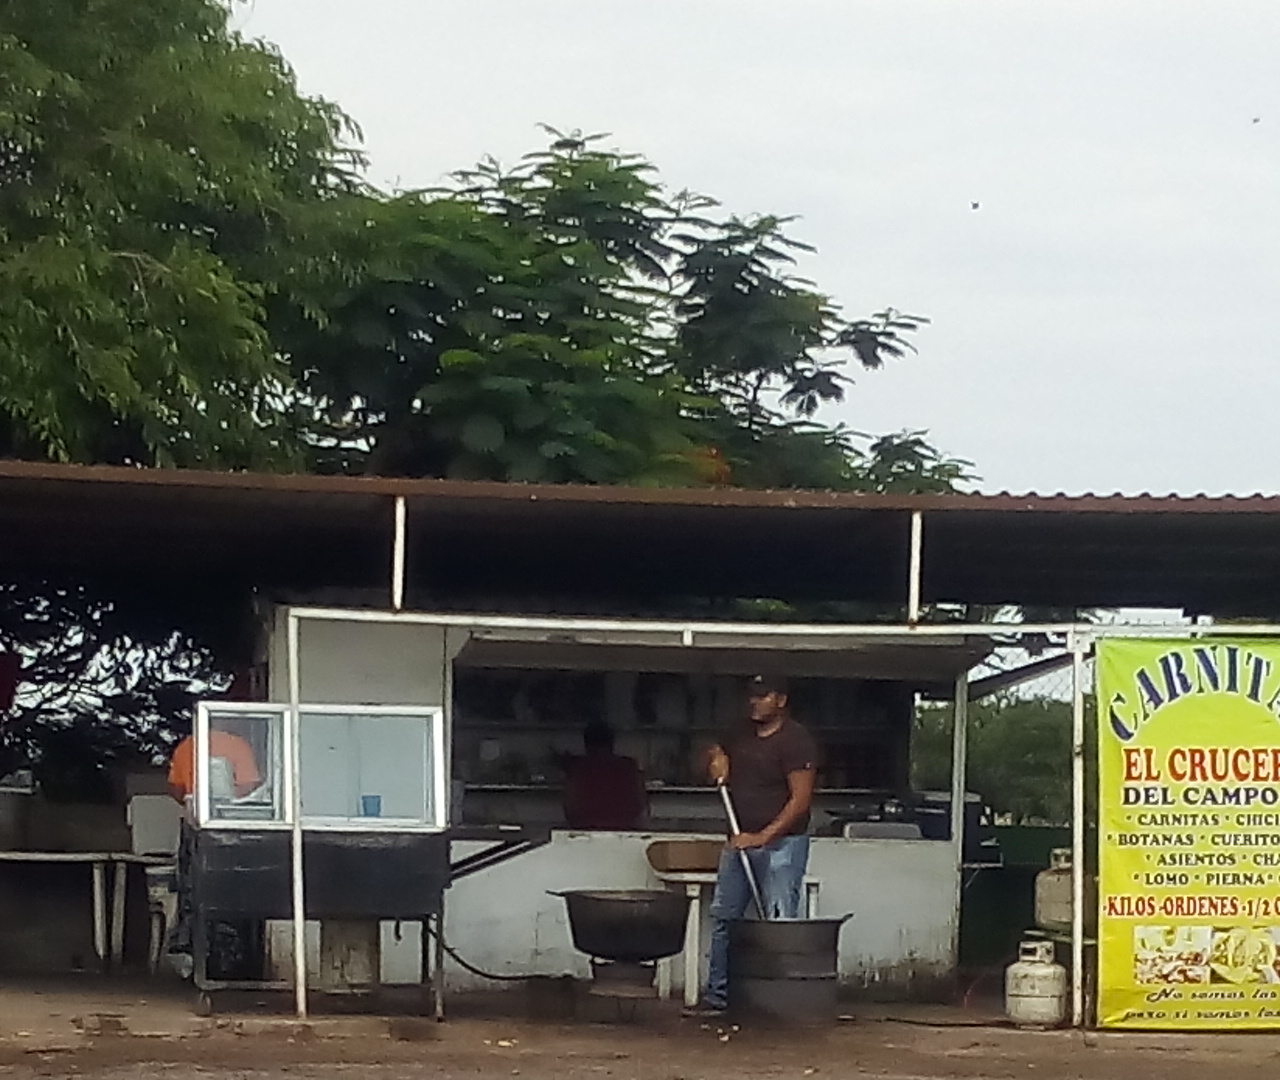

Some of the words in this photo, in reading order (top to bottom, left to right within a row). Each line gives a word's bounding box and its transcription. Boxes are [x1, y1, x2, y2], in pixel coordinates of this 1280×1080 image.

[1123, 748, 1161, 782] EL
[1122, 786, 1176, 806] DEL
[1182, 786, 1280, 807] CAMPO
[1137, 813, 1220, 827] CARNITAS
[1117, 833, 1195, 847] BOTANAS
[1156, 853, 1237, 867] ASIENTOS
[1144, 873, 1189, 886] LOMO
[1206, 873, 1266, 886] PIERNA
